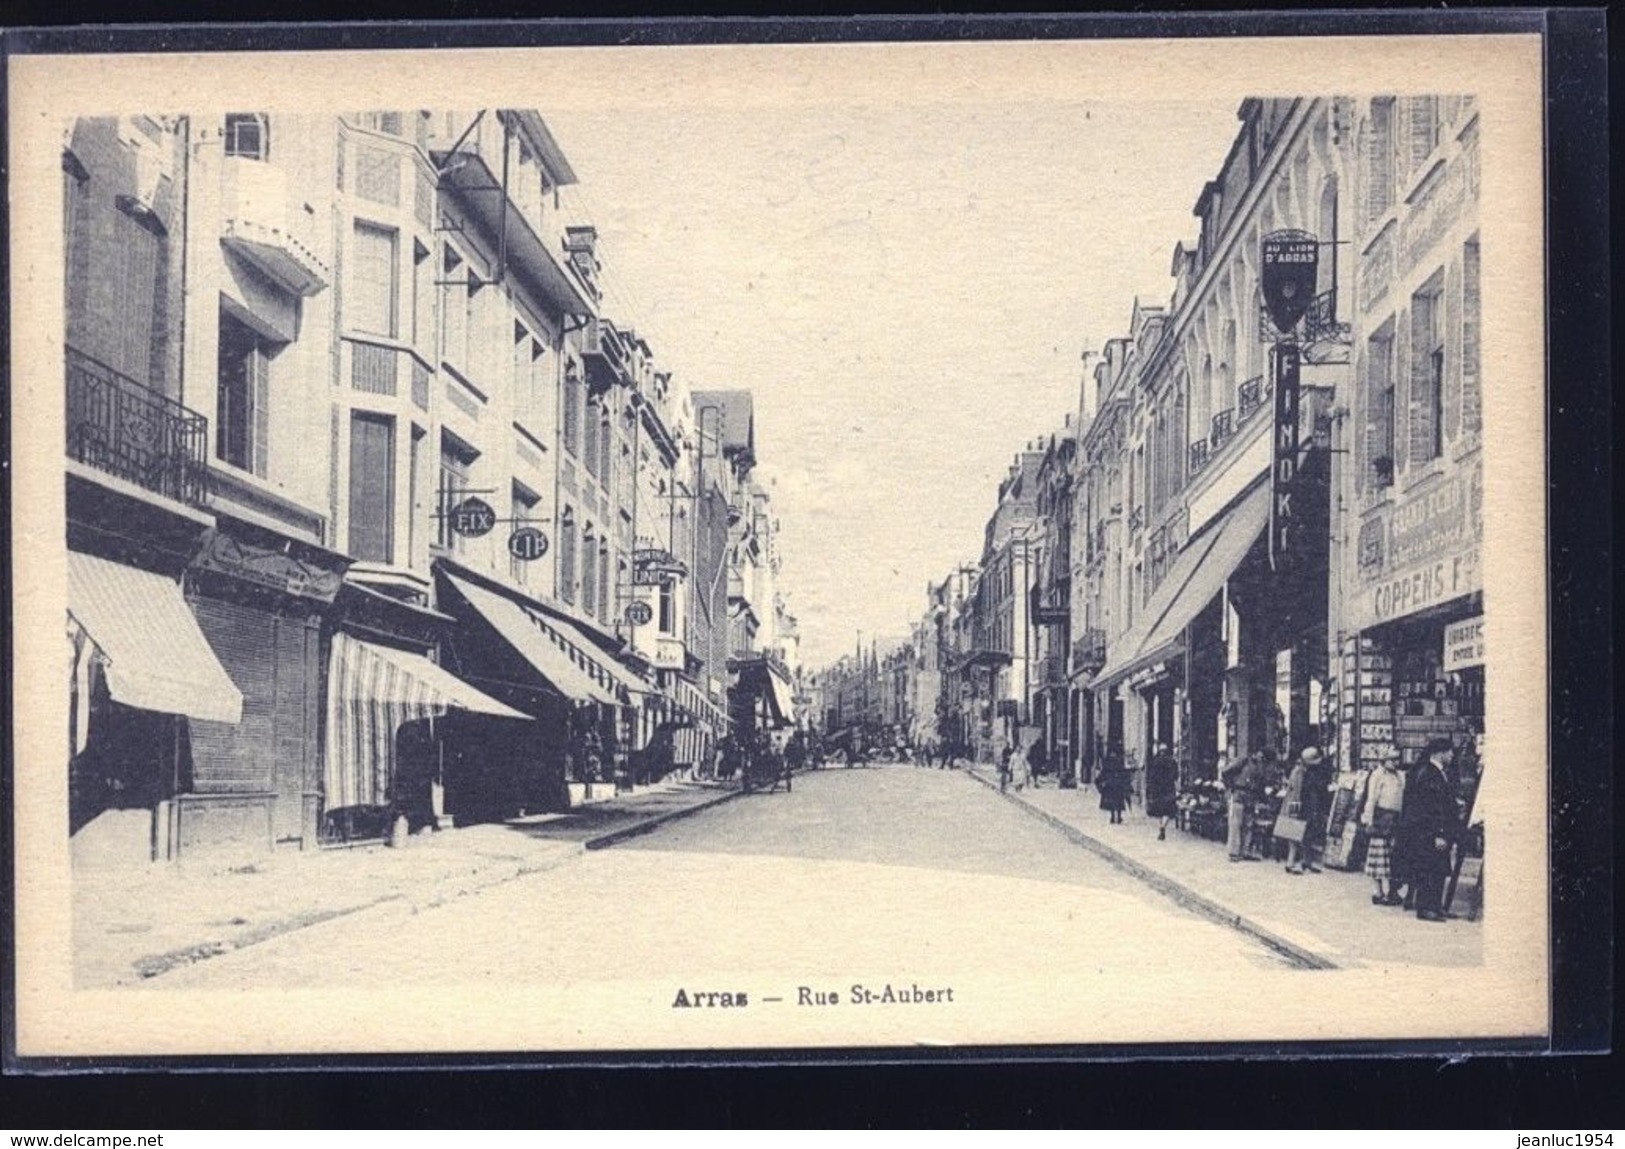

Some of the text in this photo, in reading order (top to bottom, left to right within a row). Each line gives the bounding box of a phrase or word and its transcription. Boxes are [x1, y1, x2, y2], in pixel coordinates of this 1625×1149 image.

[1266, 244, 1315, 253] AU LION
[457, 513, 490, 530] FIX
[511, 535, 546, 558] LIP
[1374, 563, 1445, 619] COPPENS
